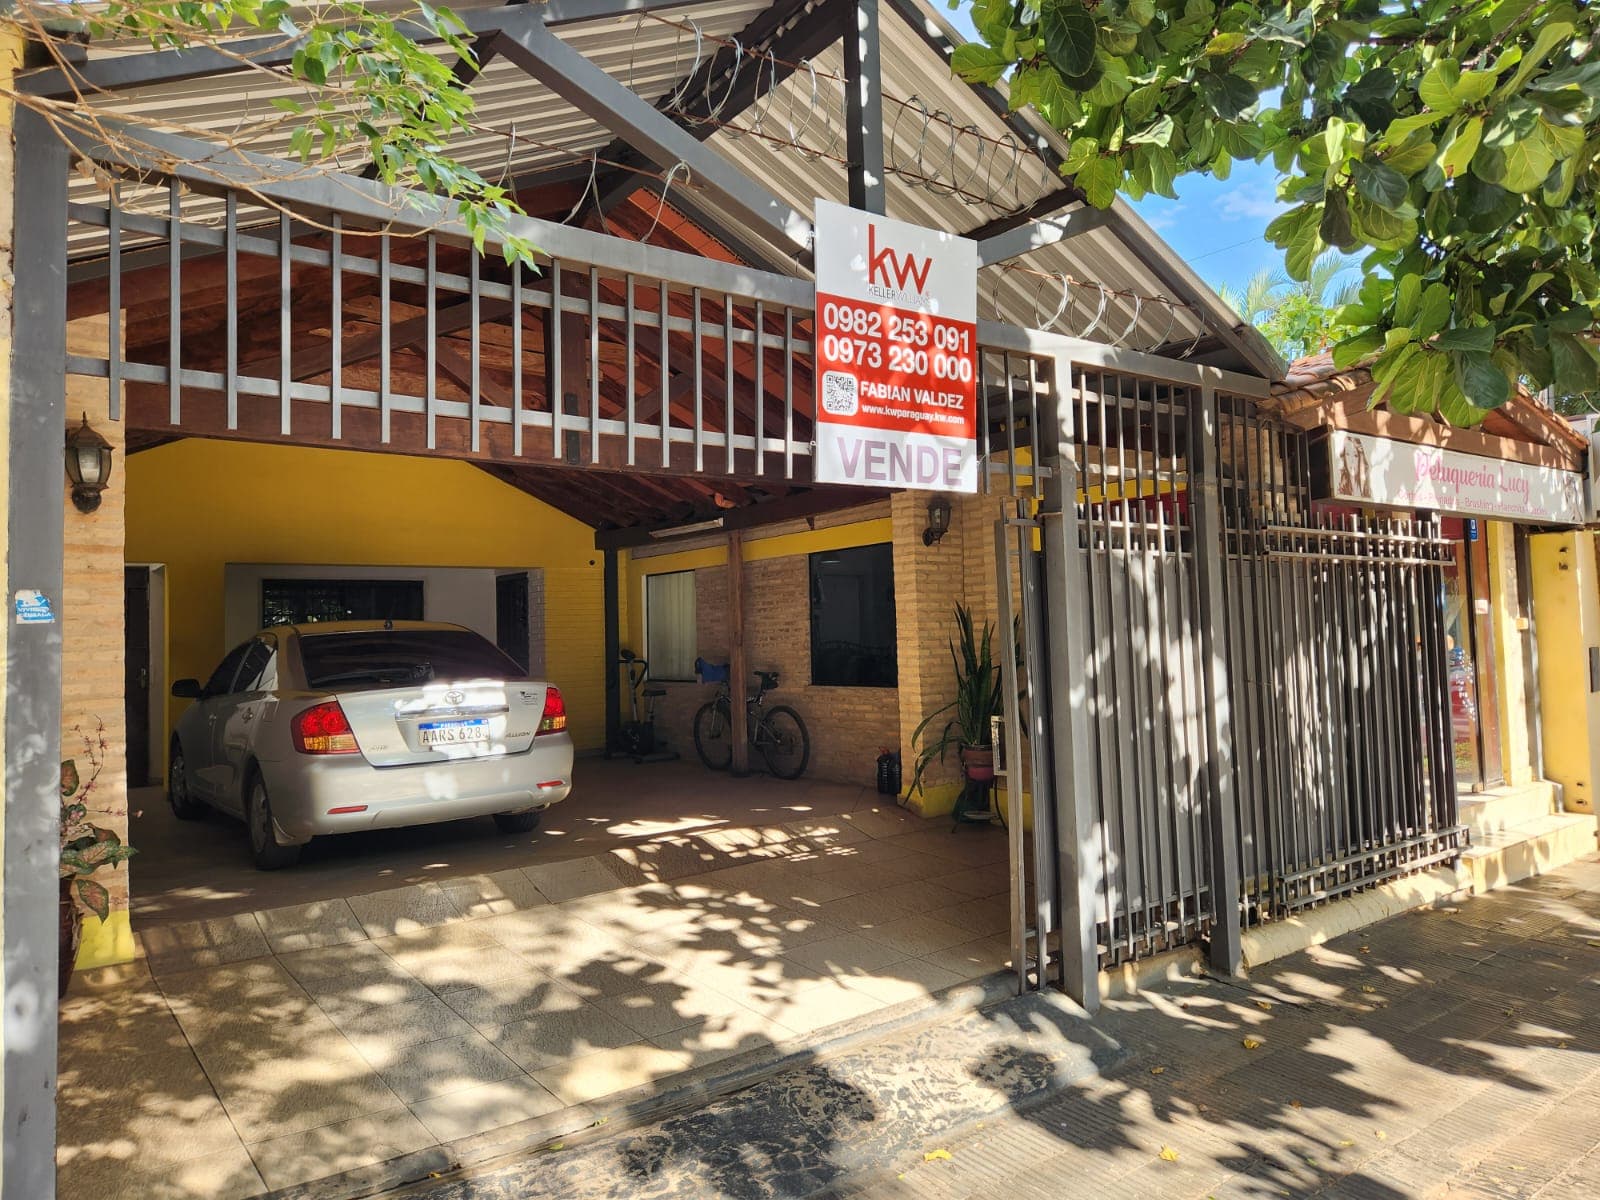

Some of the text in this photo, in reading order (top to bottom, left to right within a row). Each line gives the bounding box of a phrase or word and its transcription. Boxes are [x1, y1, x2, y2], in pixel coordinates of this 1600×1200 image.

[868, 286, 895, 299] KELLER
[823, 302, 970, 354] 0982 253 091
[823, 334, 972, 382] 0973 230 000
[860, 380, 964, 410] FABIAN VALDEZ
[862, 404, 964, 424] www.kwparaguay.kw.com
[837, 436, 962, 487] VENDE
[1499, 464, 1529, 504] Lucy
[422, 726, 482, 744] AARS 628
